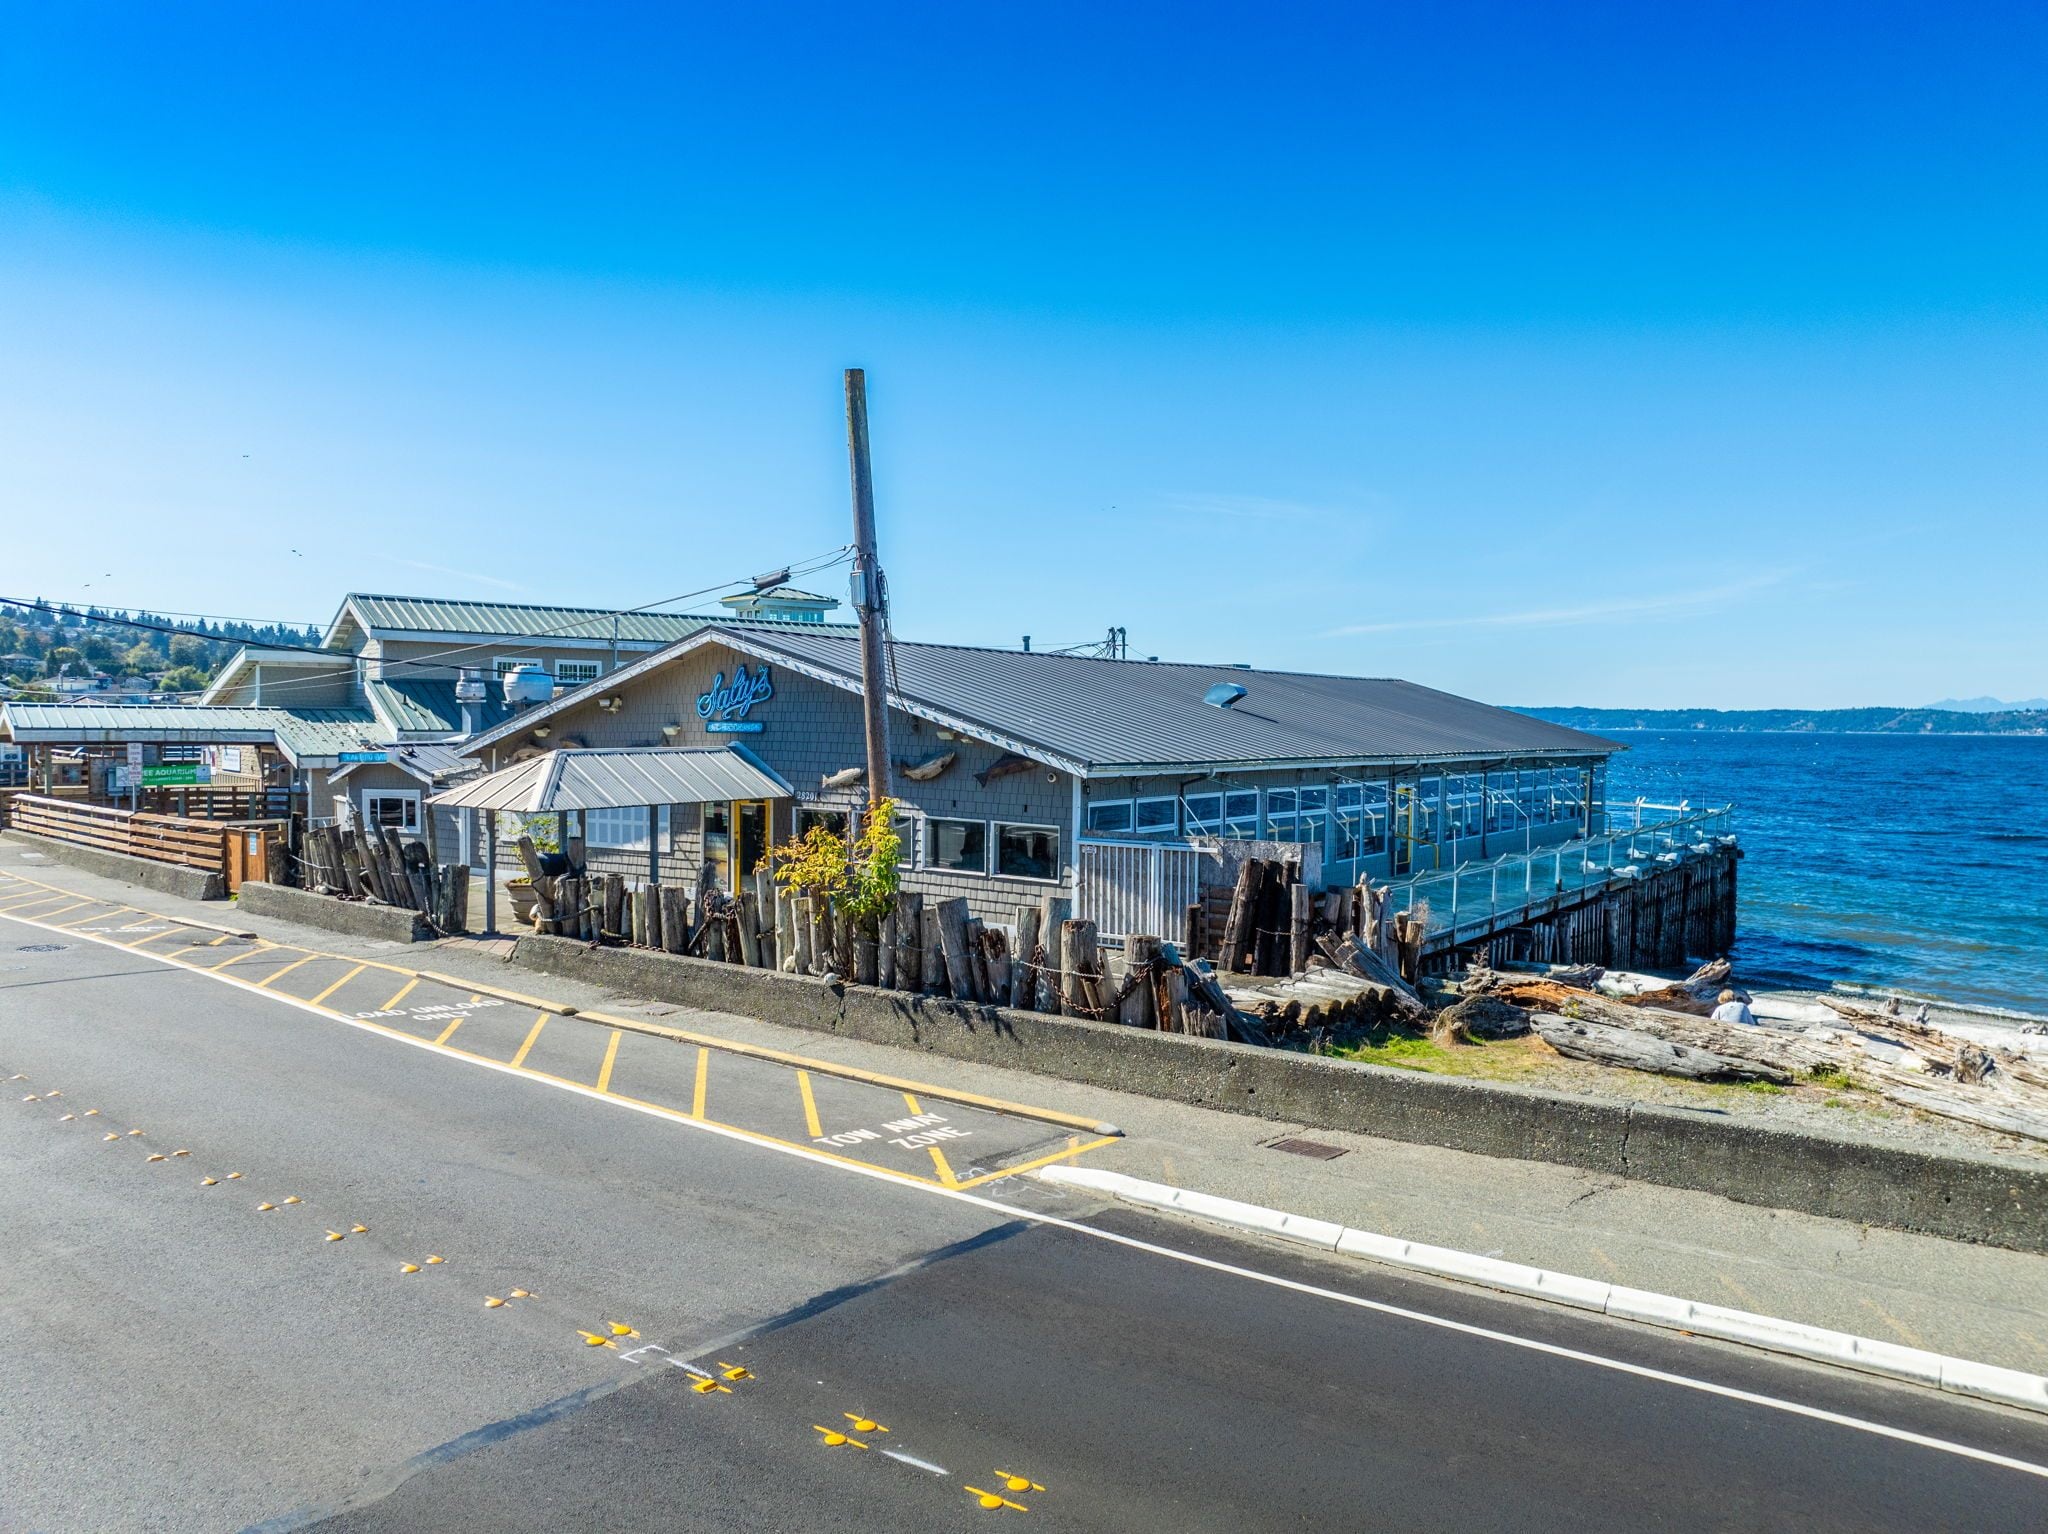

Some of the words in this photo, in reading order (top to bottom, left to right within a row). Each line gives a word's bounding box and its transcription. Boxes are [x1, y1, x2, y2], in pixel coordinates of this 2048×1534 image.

[697, 664, 773, 719] Salty's
[155, 768, 197, 776] AQUARIUM
[343, 1009, 407, 1020] LOAD
[409, 1000, 504, 1013] UNLOAD
[412, 1010, 472, 1021] ONLY
[813, 1128, 882, 1147] TOW
[881, 1112, 948, 1133] AWAY
[888, 1126, 973, 1150] ZONE
